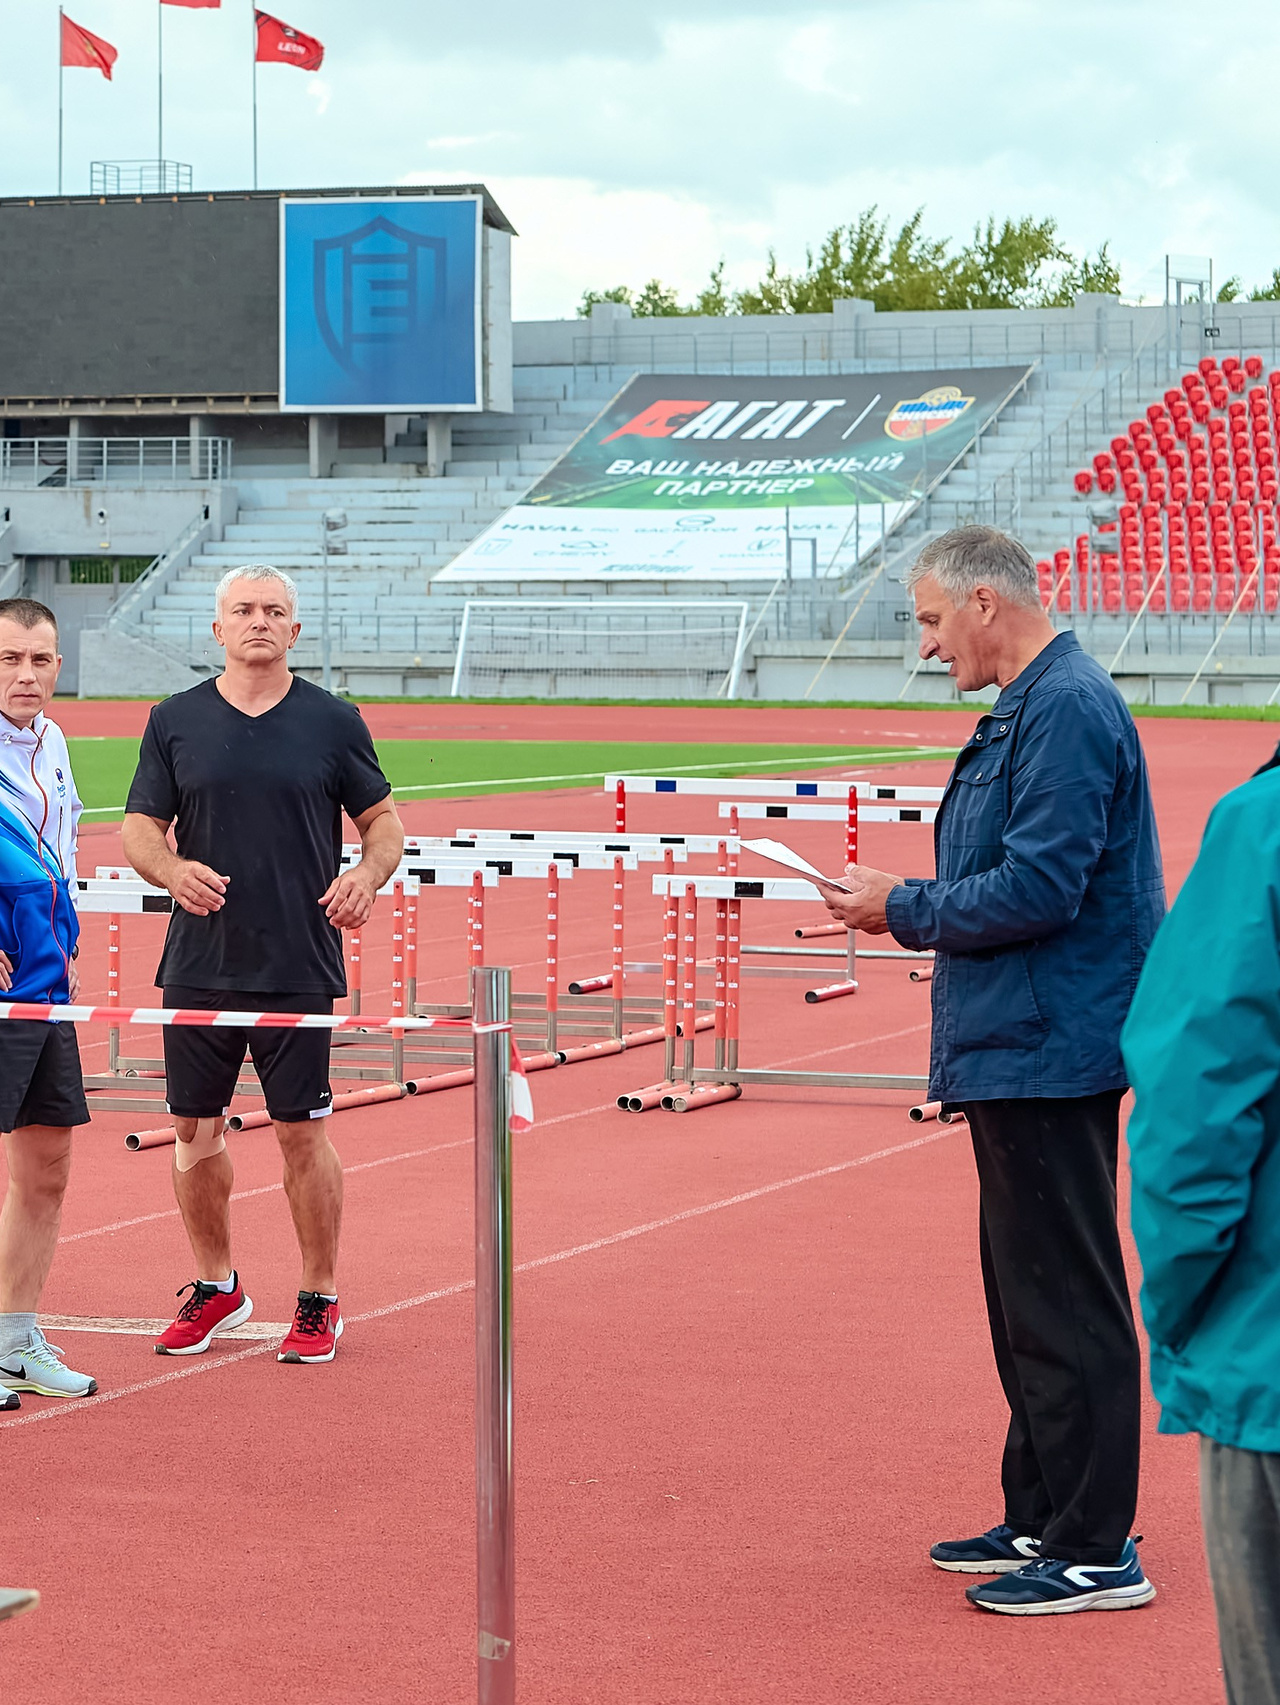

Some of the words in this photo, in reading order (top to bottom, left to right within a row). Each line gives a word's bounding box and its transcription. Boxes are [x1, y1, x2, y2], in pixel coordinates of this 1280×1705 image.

[672, 400, 846, 440] АГАТ
[605, 459, 691, 476] ВАШ
[692, 452, 905, 476] НАДЕЖНЫЙ
[653, 478, 815, 496] ПАРТНЕР
